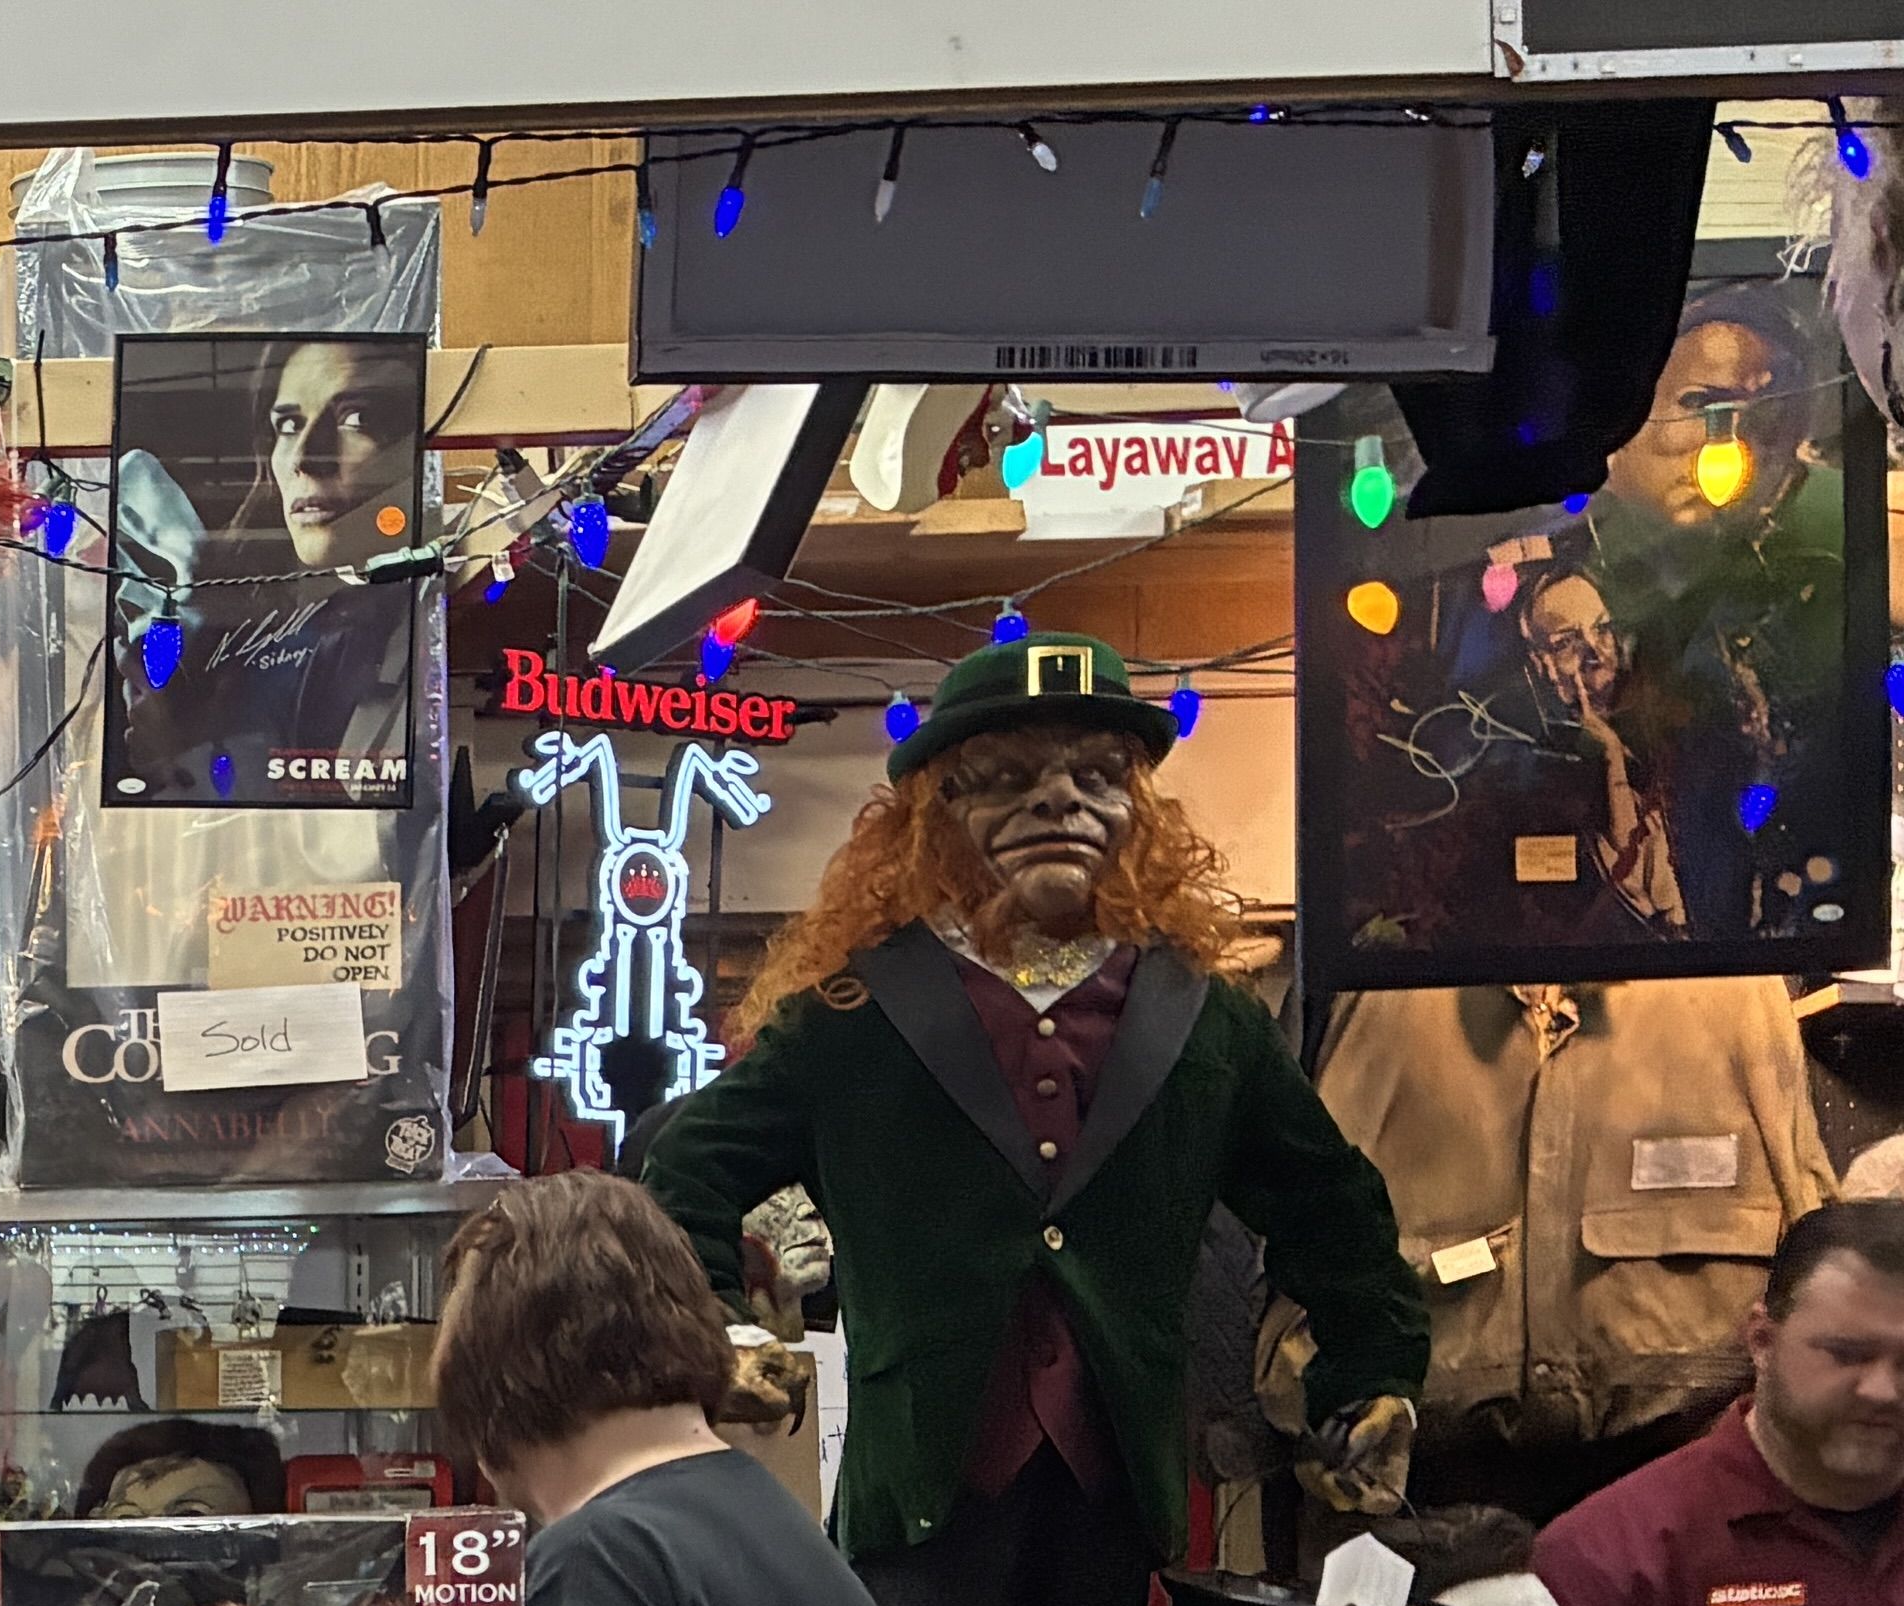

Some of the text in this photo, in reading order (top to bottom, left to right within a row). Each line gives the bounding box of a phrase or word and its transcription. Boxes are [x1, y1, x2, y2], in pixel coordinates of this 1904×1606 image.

[501, 646, 796, 741] Budweiser
[267, 758, 406, 781] SCREAM
[217, 891, 397, 933] WARNING!
[276, 923, 390, 944] POSITIVELY
[303, 943, 391, 963] DO NOT
[333, 964, 390, 982] OPEN
[201, 1017, 292, 1058] Sold
[414, 1582, 517, 1604] MOTION
